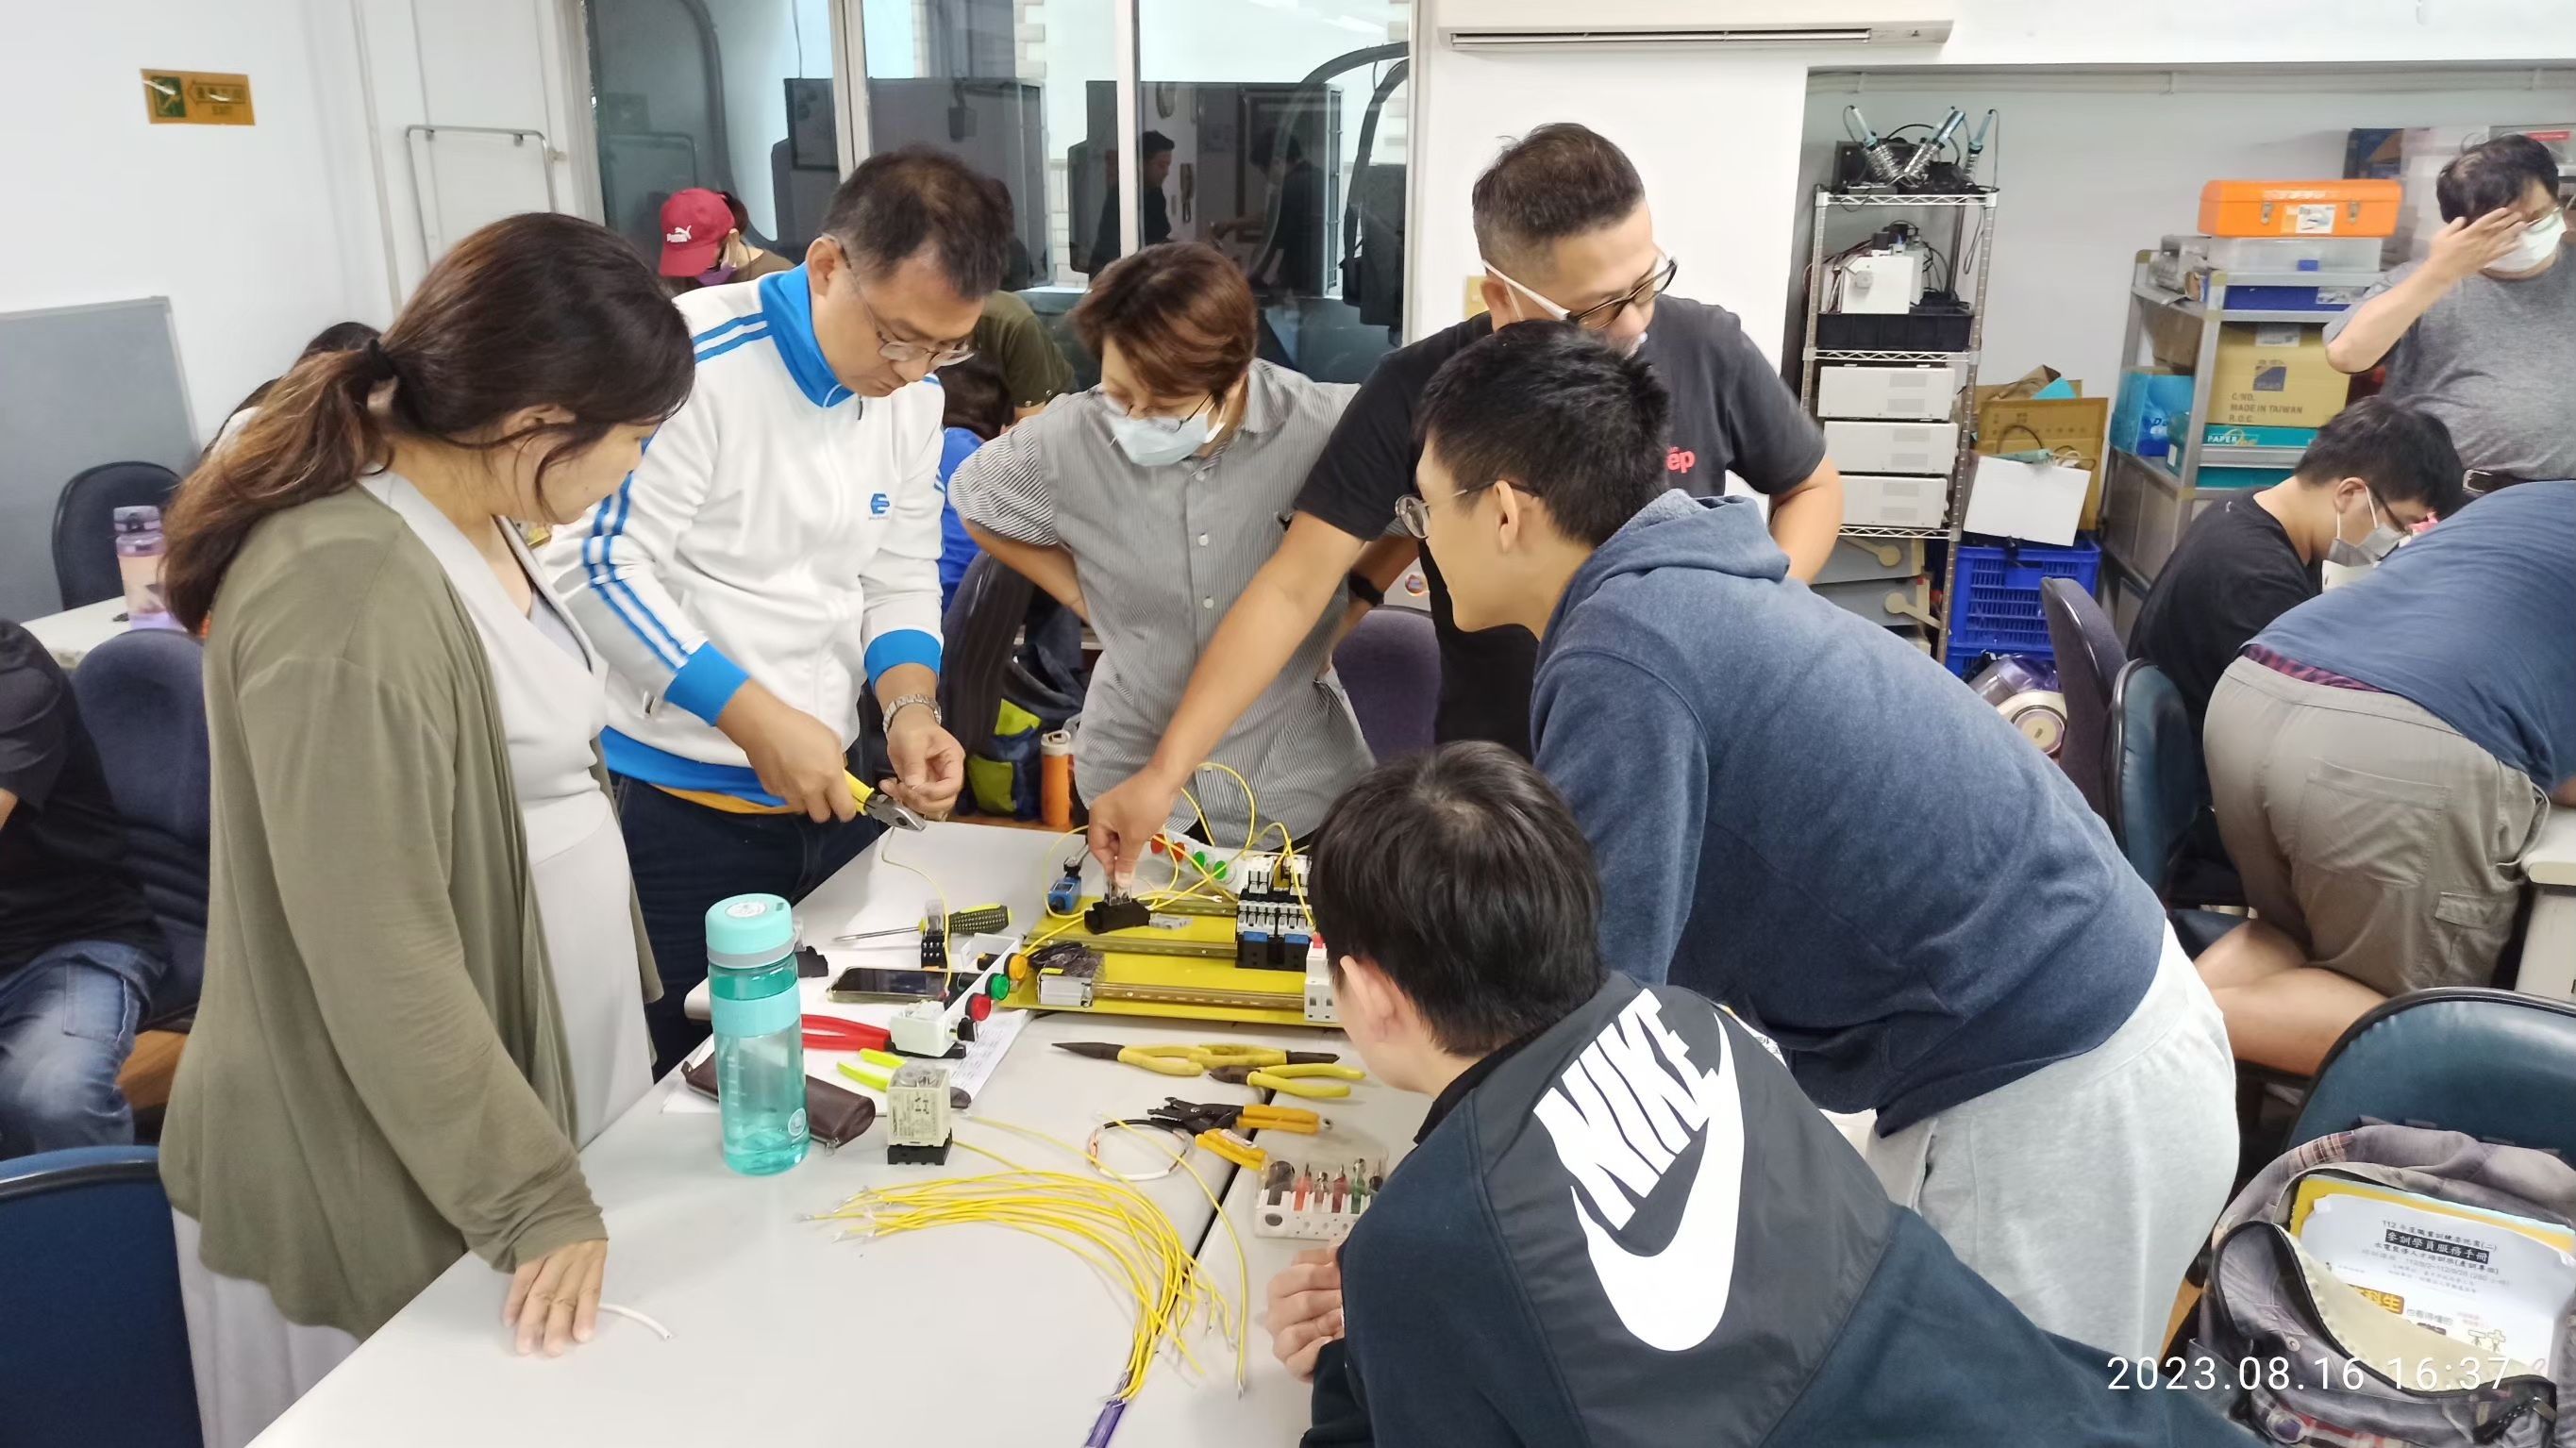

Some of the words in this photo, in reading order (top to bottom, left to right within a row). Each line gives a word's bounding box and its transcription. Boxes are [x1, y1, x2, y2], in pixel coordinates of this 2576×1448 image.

[2230, 404, 2255, 412] MADE
[2256, 404, 2267, 413] IN
[2268, 405, 2303, 414] TAIWAN
[2206, 434, 2238, 444] PAPER
[1533, 988, 1715, 1231] NIKE
[2382, 1220, 2397, 1229] 112
